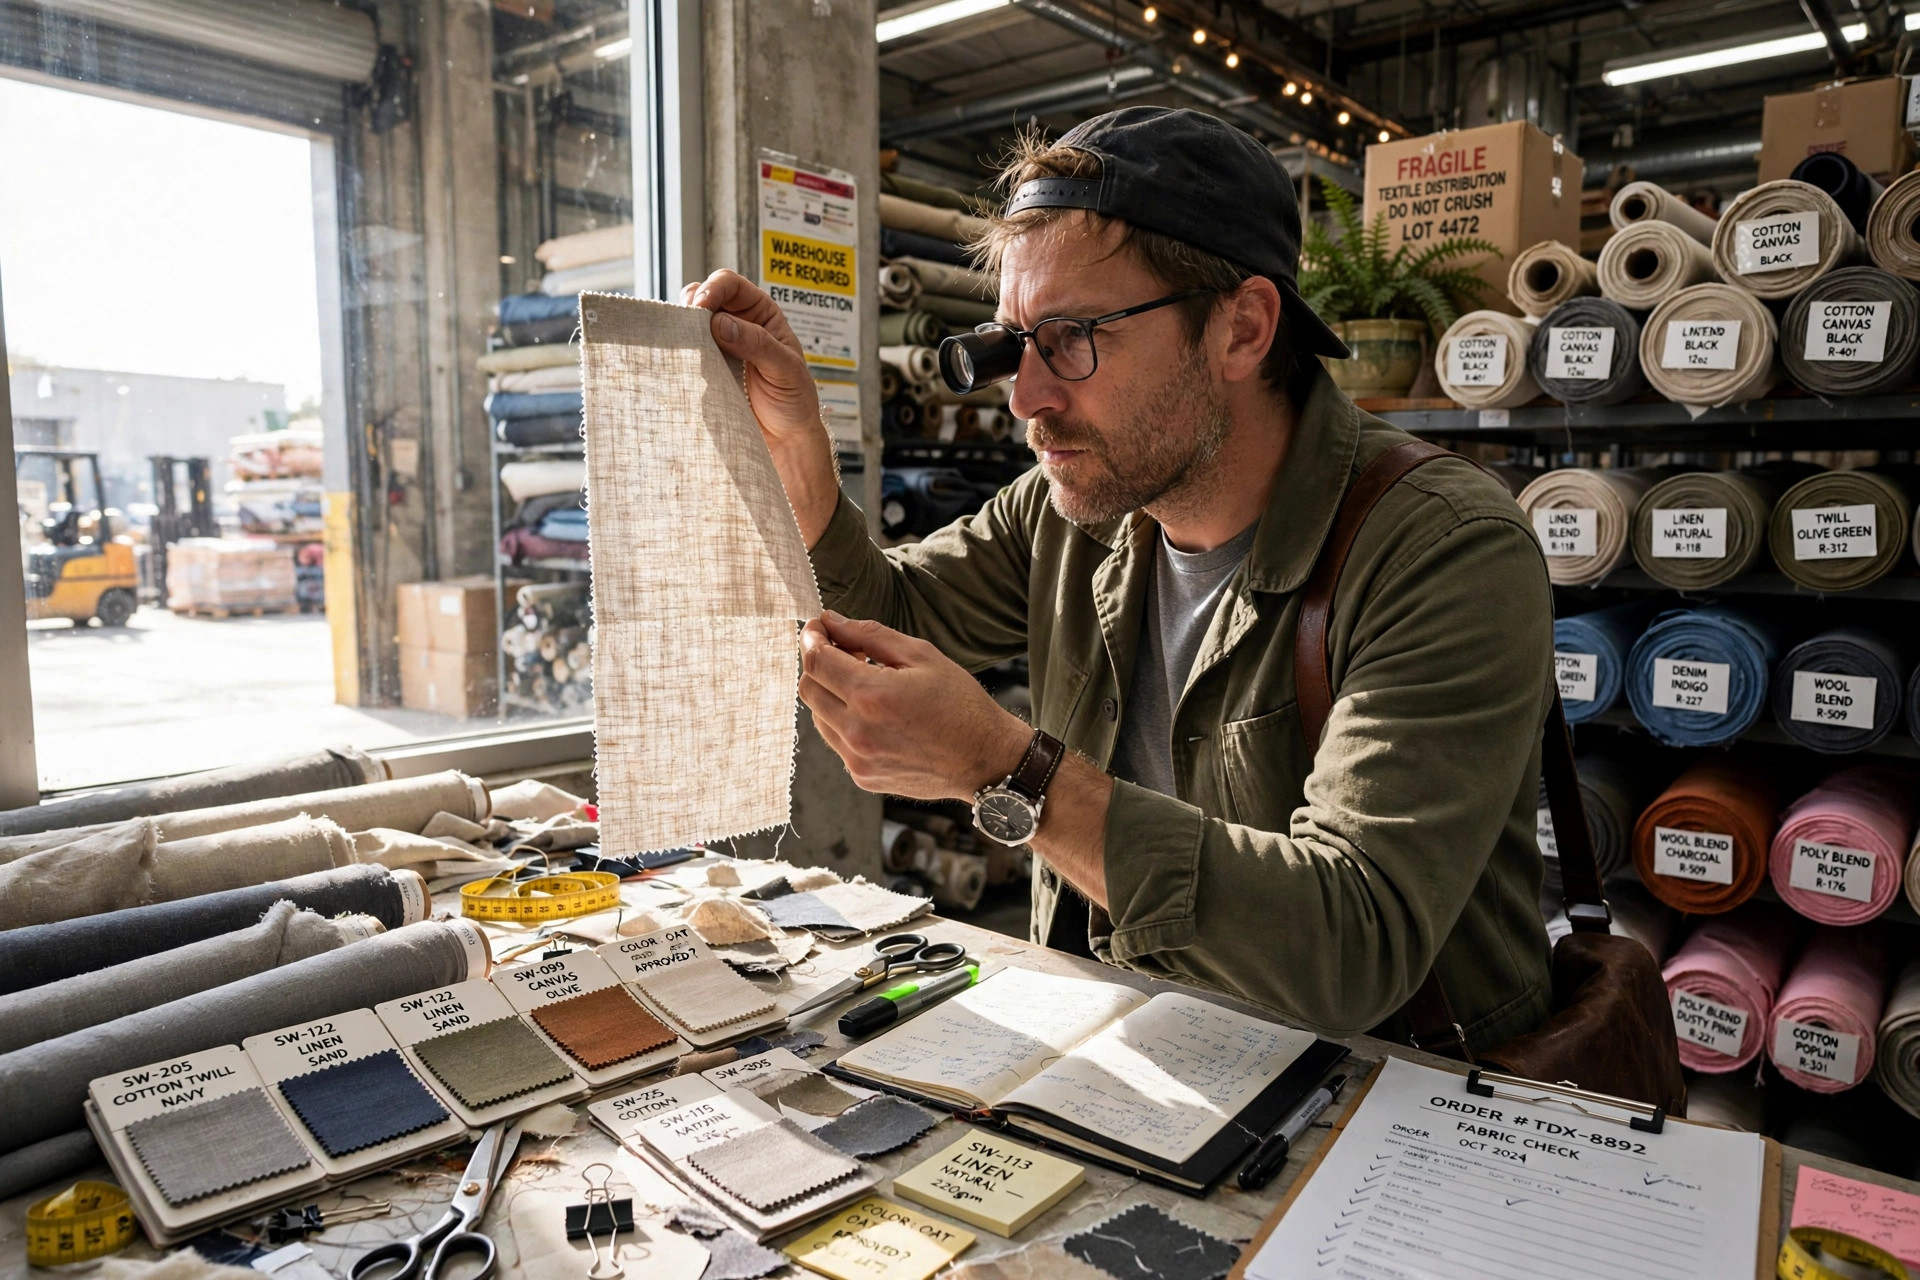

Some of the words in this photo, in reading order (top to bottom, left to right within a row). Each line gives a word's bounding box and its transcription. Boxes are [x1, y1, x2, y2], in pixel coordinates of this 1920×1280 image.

[1398, 146, 1487, 181] FRAGILE
[1378, 182, 1422, 201] TEXTILE
[1425, 171, 1507, 195] DISTRIBUTION
[1388, 200, 1408, 219] DO
[1412, 199, 1439, 216] NOT
[1444, 192, 1493, 213] CRUSH
[1402, 221, 1434, 241] LOT
[1439, 216, 1480, 236] 4472
[1751, 221, 1801, 238] COTTON
[1752, 234, 1800, 249] CANVAS
[771, 237, 847, 268] WAREHOUSE
[1760, 252, 1793, 265] BLACK
[770, 258, 793, 277] PPE
[795, 264, 850, 288] REQUIRED
[770, 286, 790, 303] EYE
[792, 290, 853, 312] PROTECTION
[1824, 305, 1875, 317] COTTON
[1822, 319, 1871, 330] CANVAS
[1459, 338, 1497, 349] COTTON
[1561, 331, 1602, 341] COTTON
[1826, 333, 1863, 344] BLACK
[1560, 343, 1599, 353] CANVAS
[1685, 340, 1718, 351] BLACK
[1828, 346, 1857, 358] R-401
[1458, 350, 1494, 360] CANVAS
[1564, 354, 1594, 364] BLACK
[1462, 362, 1489, 371] BLACK
[1549, 514, 1577, 524] LINEN
[1673, 514, 1704, 525] LINEN
[1815, 513, 1850, 524] TWILL
[1548, 528, 1580, 538] BLEND
[1664, 528, 1713, 539] NATURAL
[1797, 527, 1830, 540] OLIVE
[1833, 526, 1872, 538] GREEN
[1675, 543, 1701, 553] R-118
[1819, 543, 1848, 554] R-312
[1672, 665, 1707, 678] DENIM
[1671, 679, 1709, 693] INDIGO
[1814, 678, 1850, 692] WOOL
[1676, 694, 1703, 706] R-227
[1815, 693, 1853, 707] BLEND
[1817, 708, 1847, 721] R-509
[1659, 832, 1691, 847] WOOL
[1694, 836, 1729, 851] BLEND
[1665, 847, 1722, 864] CHARCOAL
[1800, 845, 1829, 860] POLY
[1832, 851, 1871, 868] BLEND
[1679, 863, 1707, 876] R-509
[1817, 863, 1847, 878] RUST
[1816, 877, 1846, 892] R-176
[665, 929, 689, 942] OAT
[513, 961, 565, 982] SW-099
[528, 971, 578, 991] CANVAS
[546, 983, 582, 999] OLIVE
[400, 990, 456, 1013] SW-122
[422, 1002, 465, 1021] LINEN
[1678, 996, 1705, 1014] POLY
[1706, 1004, 1742, 1026] BLEND
[431, 1014, 471, 1032] SAND
[1676, 1009, 1709, 1029] DUSTY
[1711, 1020, 1737, 1039] PINK
[273, 1022, 337, 1047] SW-122
[1792, 1027, 1839, 1049] COTTON
[297, 1034, 344, 1055] LINEN
[1795, 1041, 1836, 1061] POPLIN
[308, 1048, 348, 1067] SAND
[122, 1060, 193, 1088] SW-205
[112, 1079, 183, 1107] COTTON
[188, 1065, 236, 1086] TWILL
[161, 1086, 206, 1108] NAVY
[1429, 1095, 1504, 1123] ORDER
[1456, 1121, 1517, 1144] FABRIC
[1522, 1137, 1580, 1161] CHECK
[967, 1141, 1034, 1171] SW-113
[1459, 1138, 1488, 1152] OCT
[1492, 1146, 1527, 1164] 2024
[951, 1153, 1015, 1182] LINEN
[939, 1165, 997, 1193] NATURAL
[919, 1224, 956, 1243] OAT
